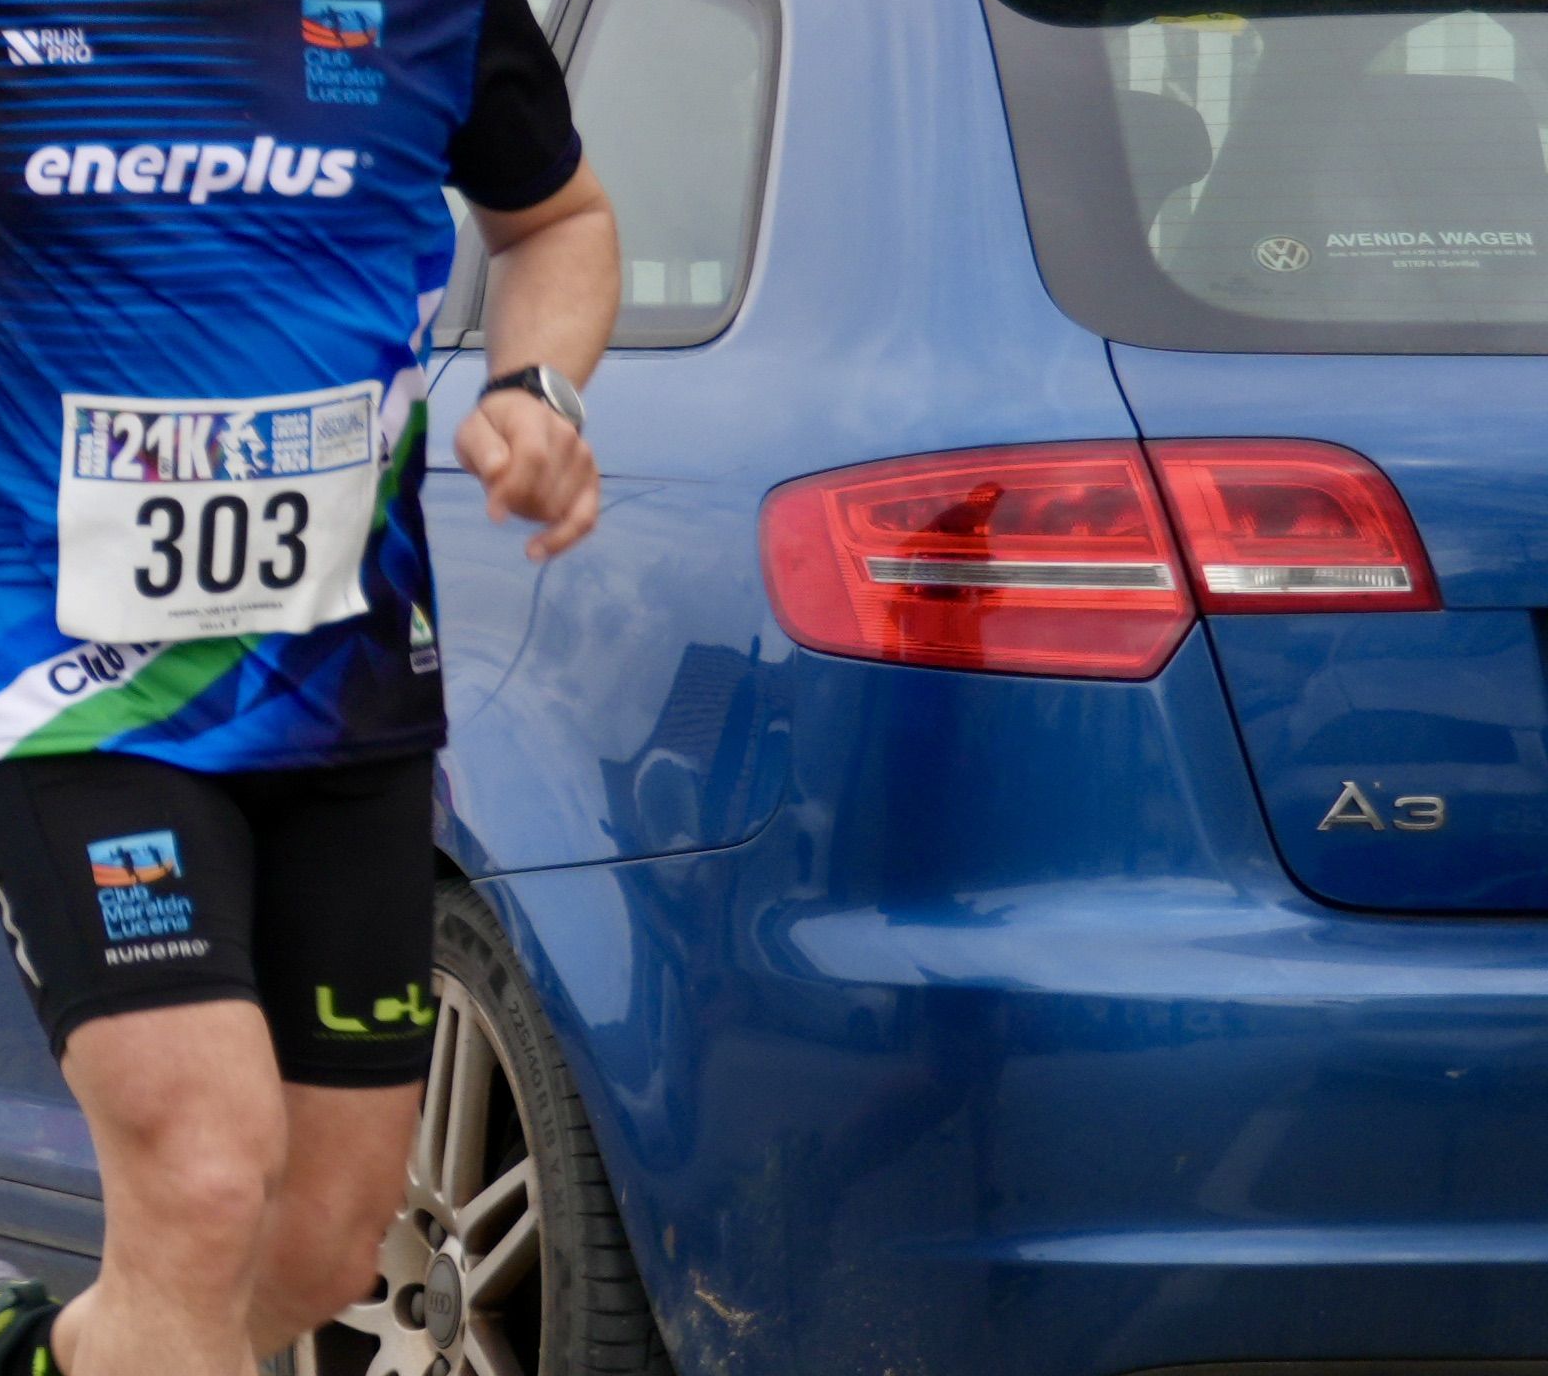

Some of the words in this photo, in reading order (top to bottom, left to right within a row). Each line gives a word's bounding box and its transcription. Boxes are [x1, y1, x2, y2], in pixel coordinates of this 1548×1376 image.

[40, 28, 85, 44] RUN
[46, 44, 91, 63] PRO
[304, 48, 351, 65] Club
[25, 135, 357, 204] enerplus
[1326, 231, 1435, 248] AVENIDA
[1438, 231, 1534, 247] WAGEN
[110, 412, 214, 481] 21K
[133, 490, 310, 598] 303
[1316, 781, 1446, 831] A3
